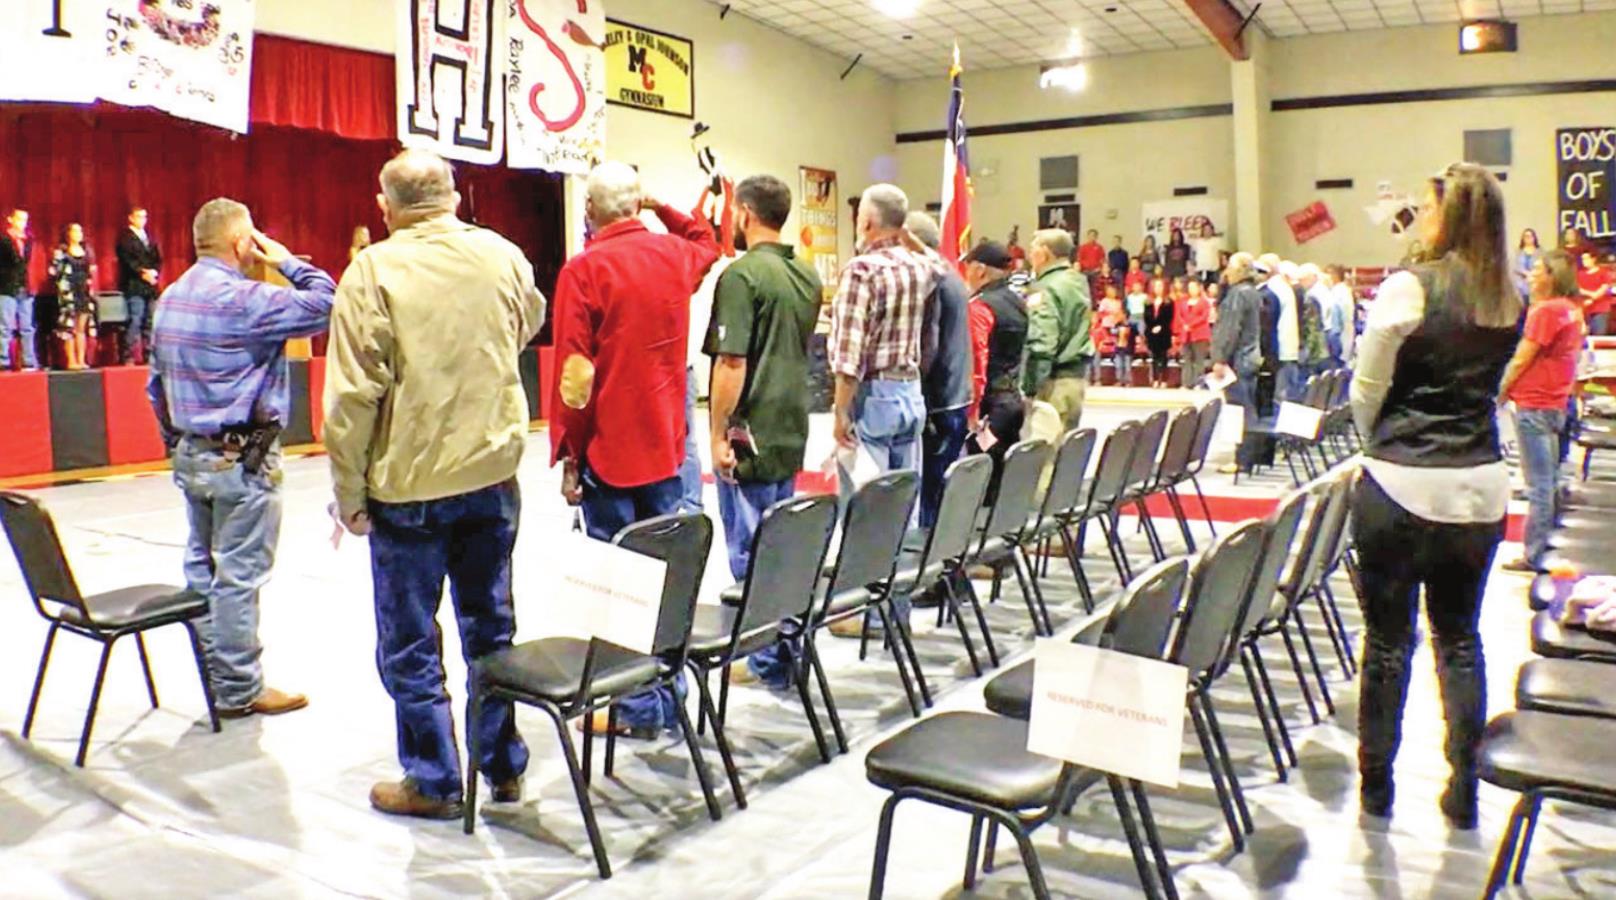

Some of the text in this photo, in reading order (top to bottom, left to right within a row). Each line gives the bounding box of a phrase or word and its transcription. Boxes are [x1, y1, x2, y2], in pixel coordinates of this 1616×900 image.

[1560, 129, 1616, 161] BOYS
[1566, 171, 1605, 200] OF
[1145, 217, 1165, 232] WE
[1560, 209, 1616, 238] FALL
